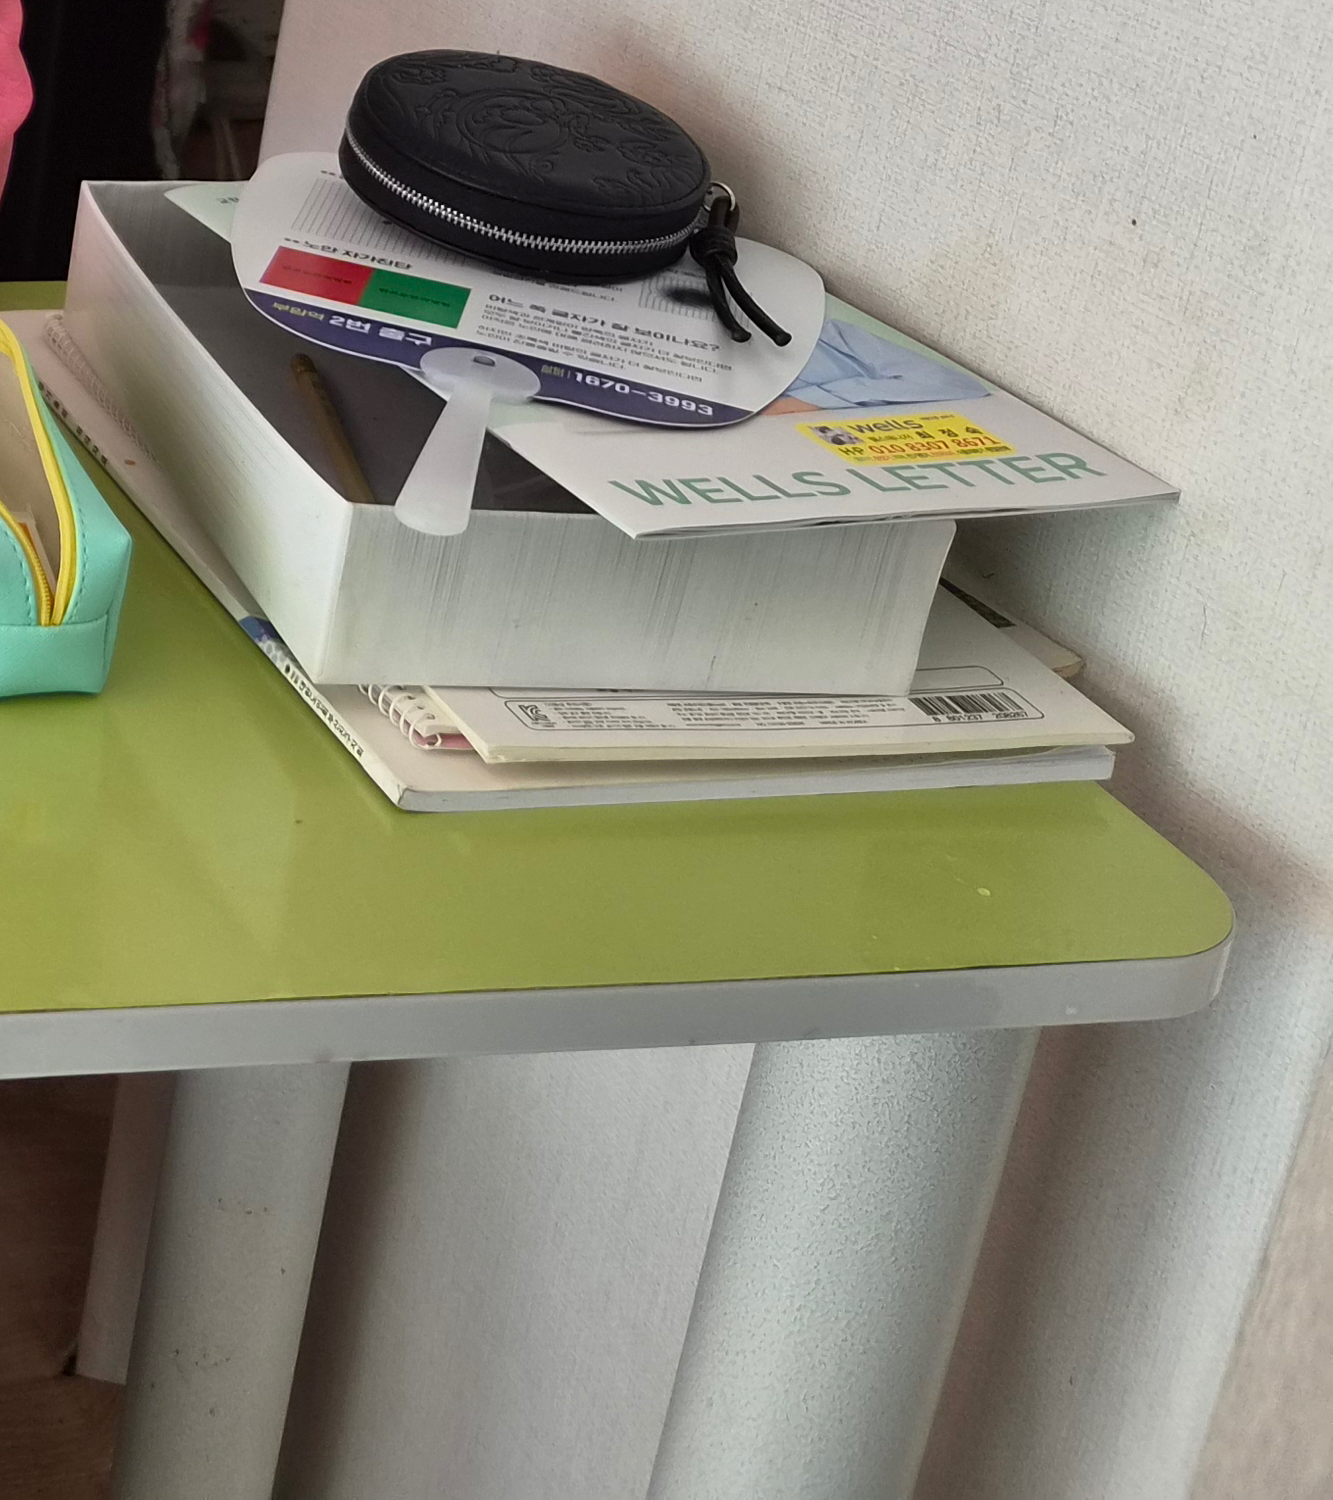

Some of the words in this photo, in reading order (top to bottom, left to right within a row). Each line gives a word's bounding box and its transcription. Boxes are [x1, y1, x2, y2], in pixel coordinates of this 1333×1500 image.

[329, 314, 372, 335] 2번
[488, 293, 524, 309] 어느
[634, 326, 721, 352] 보이나요?
[573, 369, 714, 417] 1670-3993
[847, 418, 925, 435] wells
[838, 446, 864, 457] HP
[867, 442, 906, 455] 010
[951, 435, 1002, 449] 8671
[609, 471, 852, 506] WELLS
[845, 451, 1108, 493] LETTER
